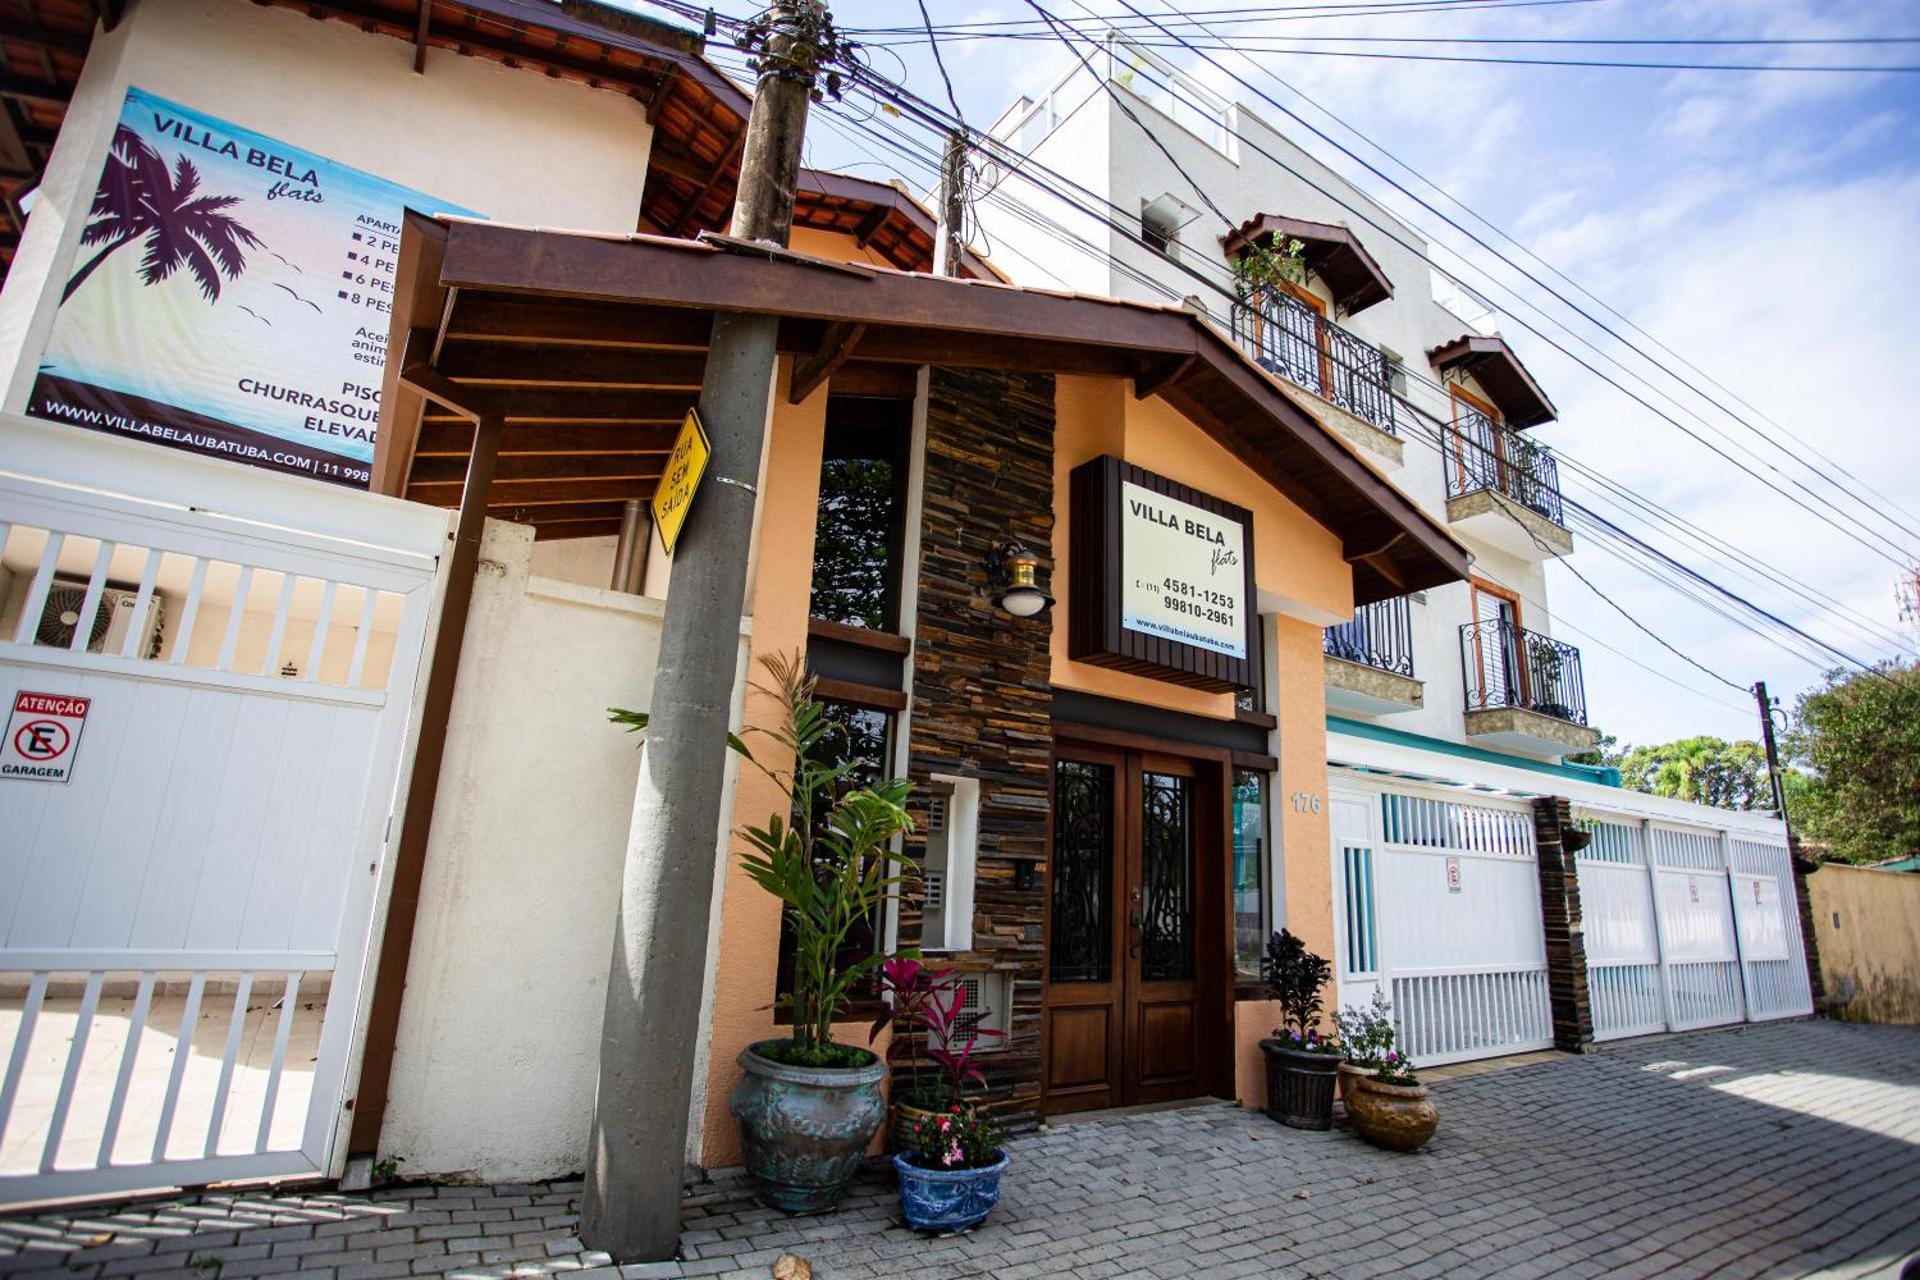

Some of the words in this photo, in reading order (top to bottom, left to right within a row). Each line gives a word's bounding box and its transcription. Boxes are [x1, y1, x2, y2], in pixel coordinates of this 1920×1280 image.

[153, 112, 239, 160] VILLA
[246, 148, 319, 187] BELA
[267, 181, 325, 203] flats
[367, 236, 377, 247] 2
[360, 255, 370, 266] 4
[355, 274, 366, 285] 6
[351, 293, 361, 304] 8
[46, 400, 311, 470] WWW.VILLABELAUBATUBA.COM
[323, 462, 339, 476] 11
[675, 435, 692, 462] RUA
[670, 459, 690, 489] SEM
[1130, 499, 1180, 531] VILLA
[1184, 519, 1225, 547] BELA
[1211, 549, 1238, 576] flats
[1163, 577, 1234, 610] 4581-1253
[1164, 596, 1234, 628] 99810-2961
[18, 696, 86, 716] ATENÇÃO
[1, 764, 65, 778] GARAGEM
[1292, 791, 1322, 816] 176
